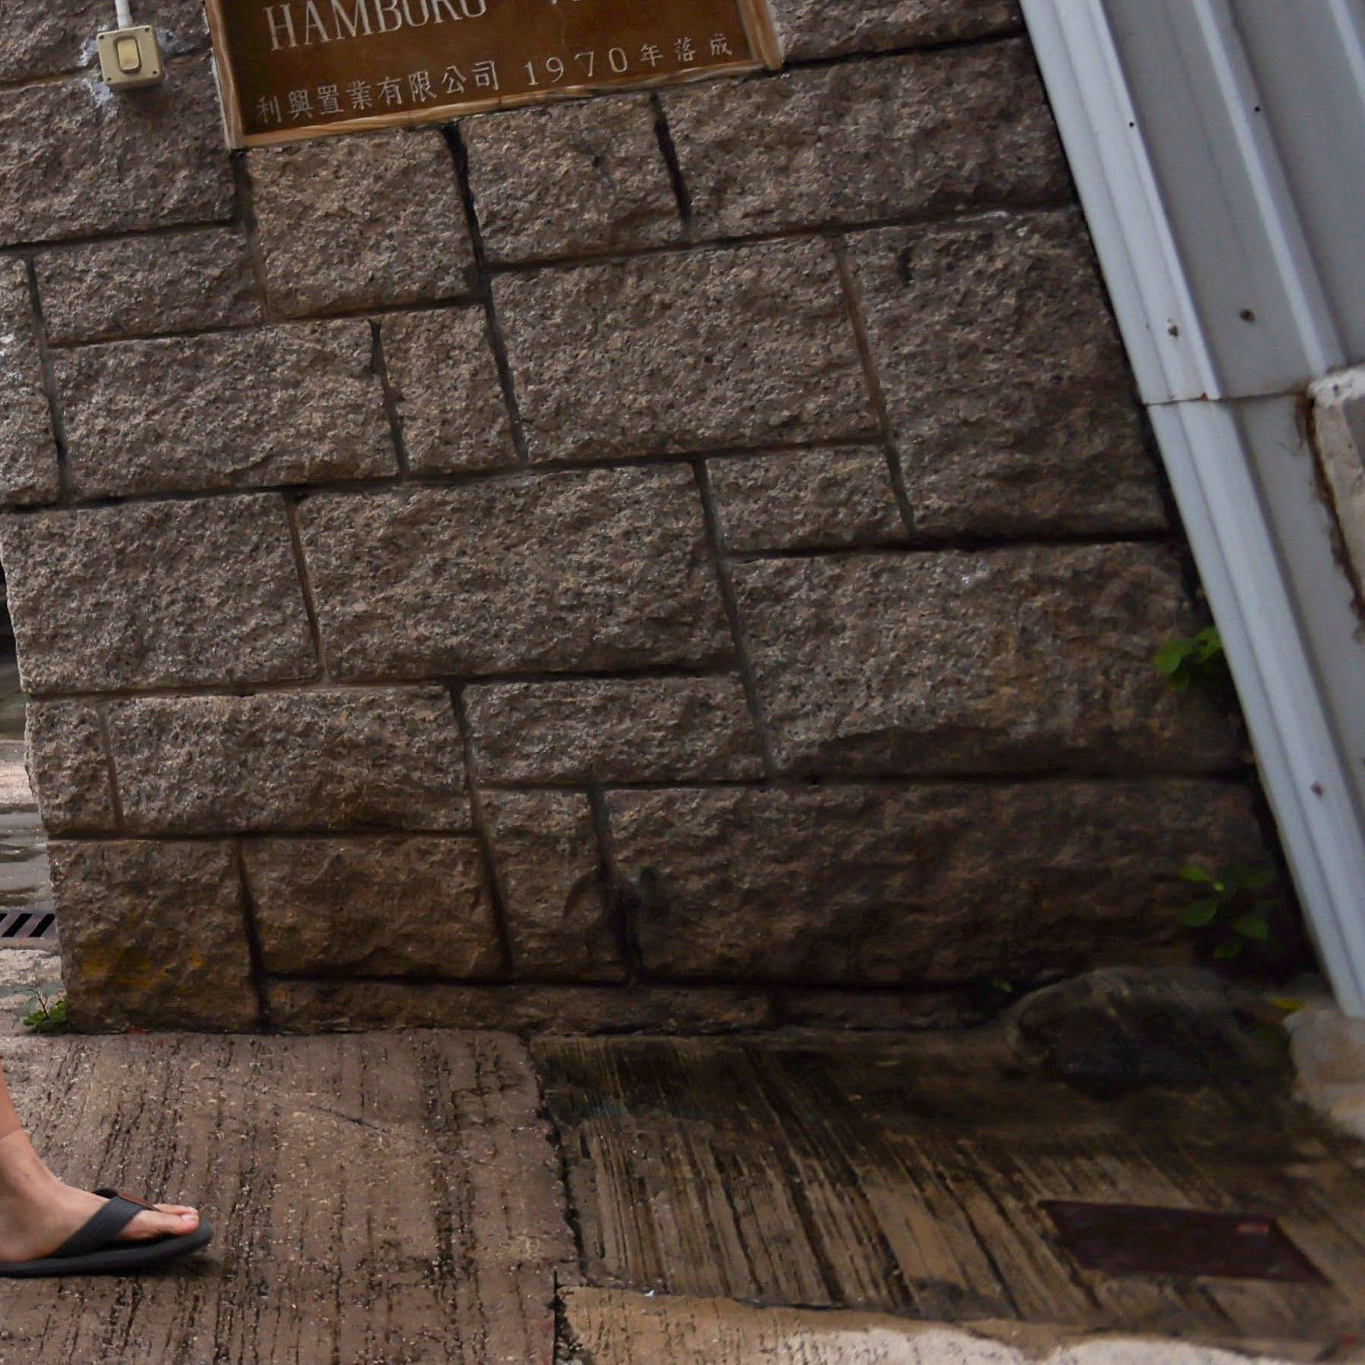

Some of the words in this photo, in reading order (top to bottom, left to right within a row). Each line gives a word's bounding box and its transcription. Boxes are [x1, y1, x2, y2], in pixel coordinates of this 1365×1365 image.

[255, 58, 500, 124] 利興置業有限公司
